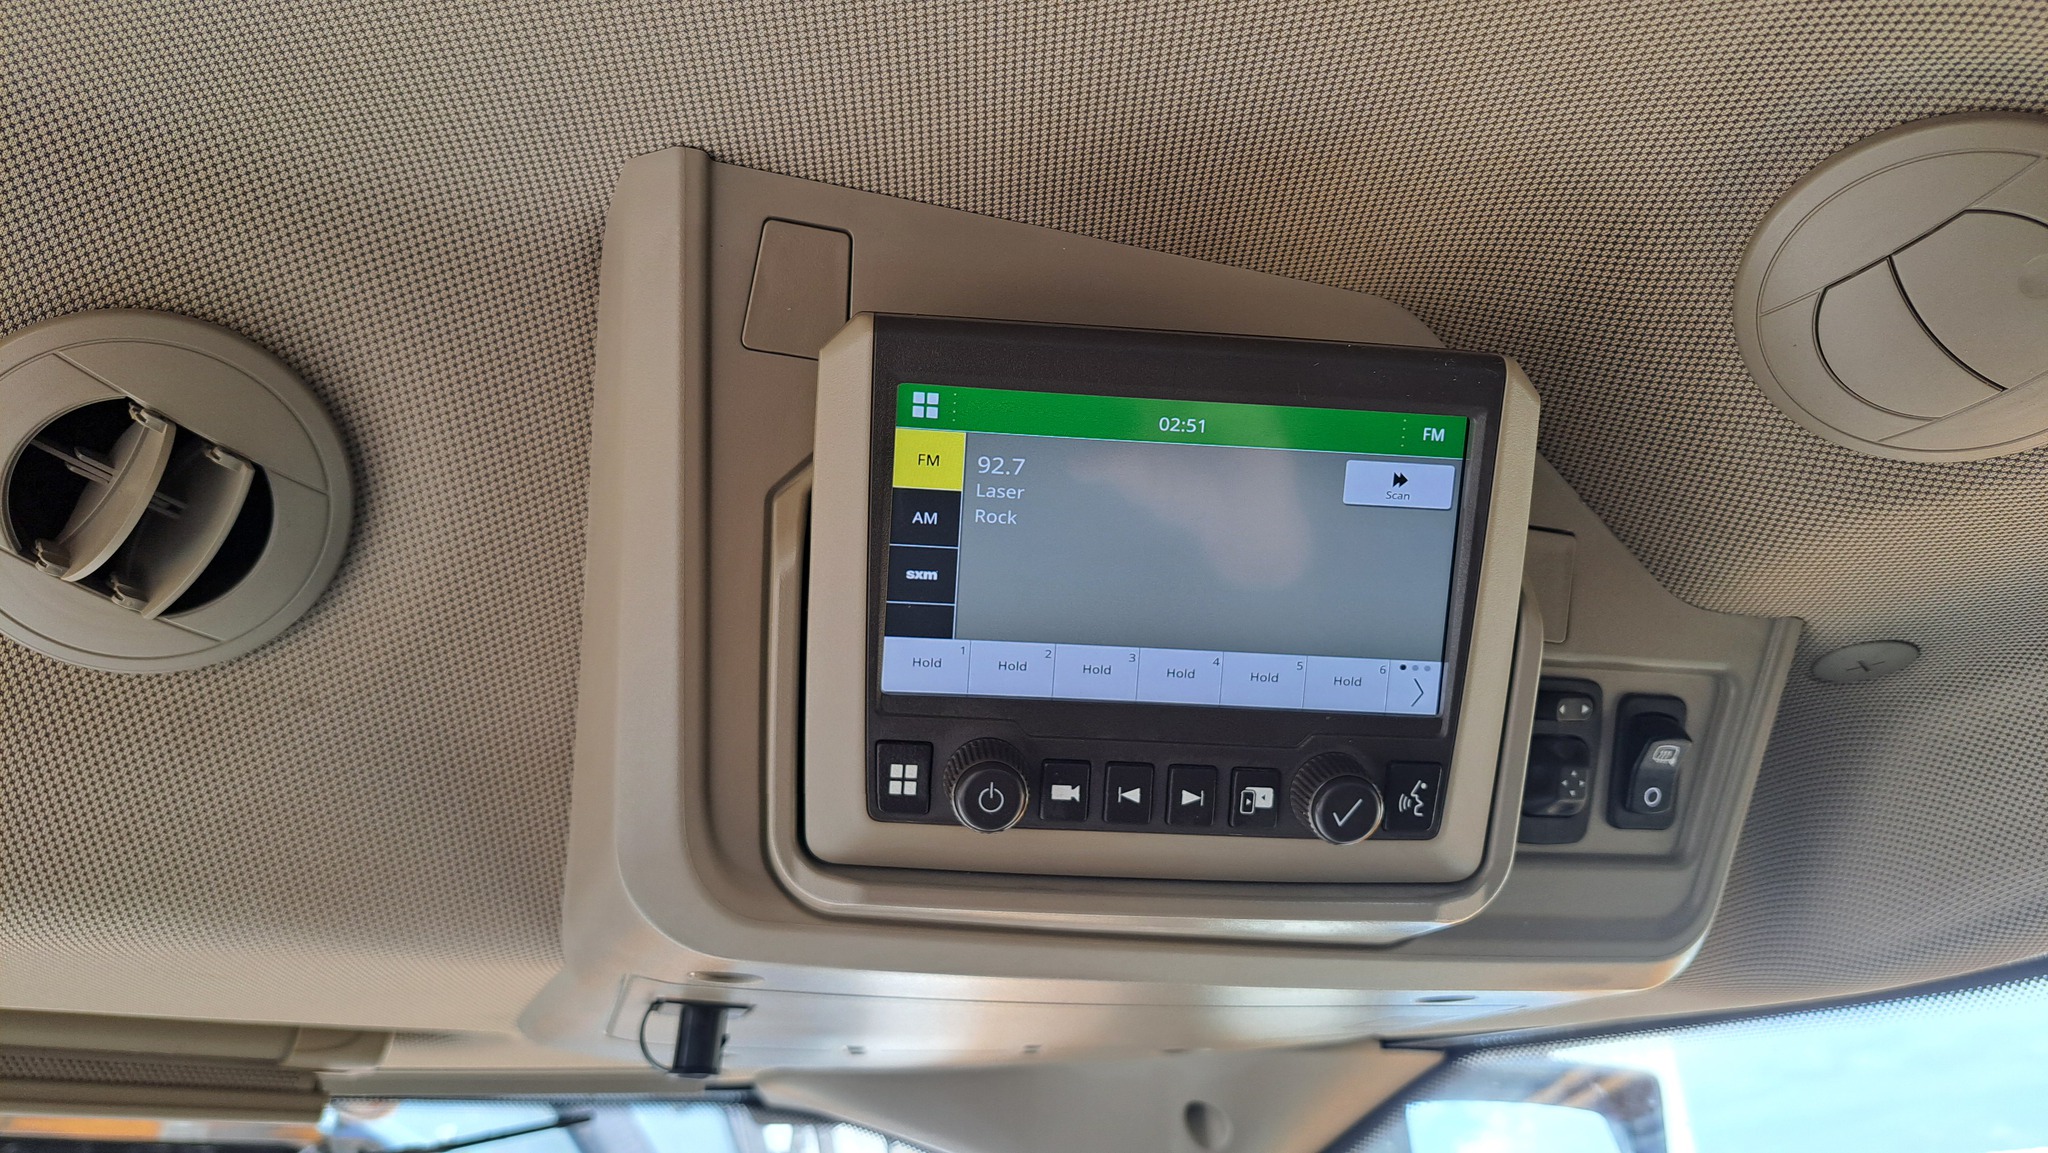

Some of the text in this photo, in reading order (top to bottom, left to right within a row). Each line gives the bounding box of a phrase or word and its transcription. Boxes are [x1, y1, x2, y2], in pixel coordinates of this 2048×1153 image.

[1158, 416, 1207, 434] 02:51
[1422, 427, 1446, 442] FM
[917, 453, 941, 467] FM
[977, 456, 1026, 476] 92.7
[976, 483, 1025, 499] Laser
[1385, 490, 1411, 501] Scan
[912, 511, 938, 525] AM
[974, 509, 1017, 525] Rock
[905, 569, 938, 581] sxm
[960, 646, 966, 655] 1
[1044, 649, 1052, 659] 2
[912, 656, 942, 668] Hold
[1128, 653, 1137, 663] 3
[1212, 657, 1220, 667] 4
[998, 660, 1027, 672] Hold
[1082, 663, 1112, 675] Hold
[1296, 661, 1304, 671] 5
[1379, 665, 1387, 675] 6
[1166, 668, 1195, 679] Hold
[1250, 672, 1279, 683] Hold
[1333, 676, 1362, 687] Hold
